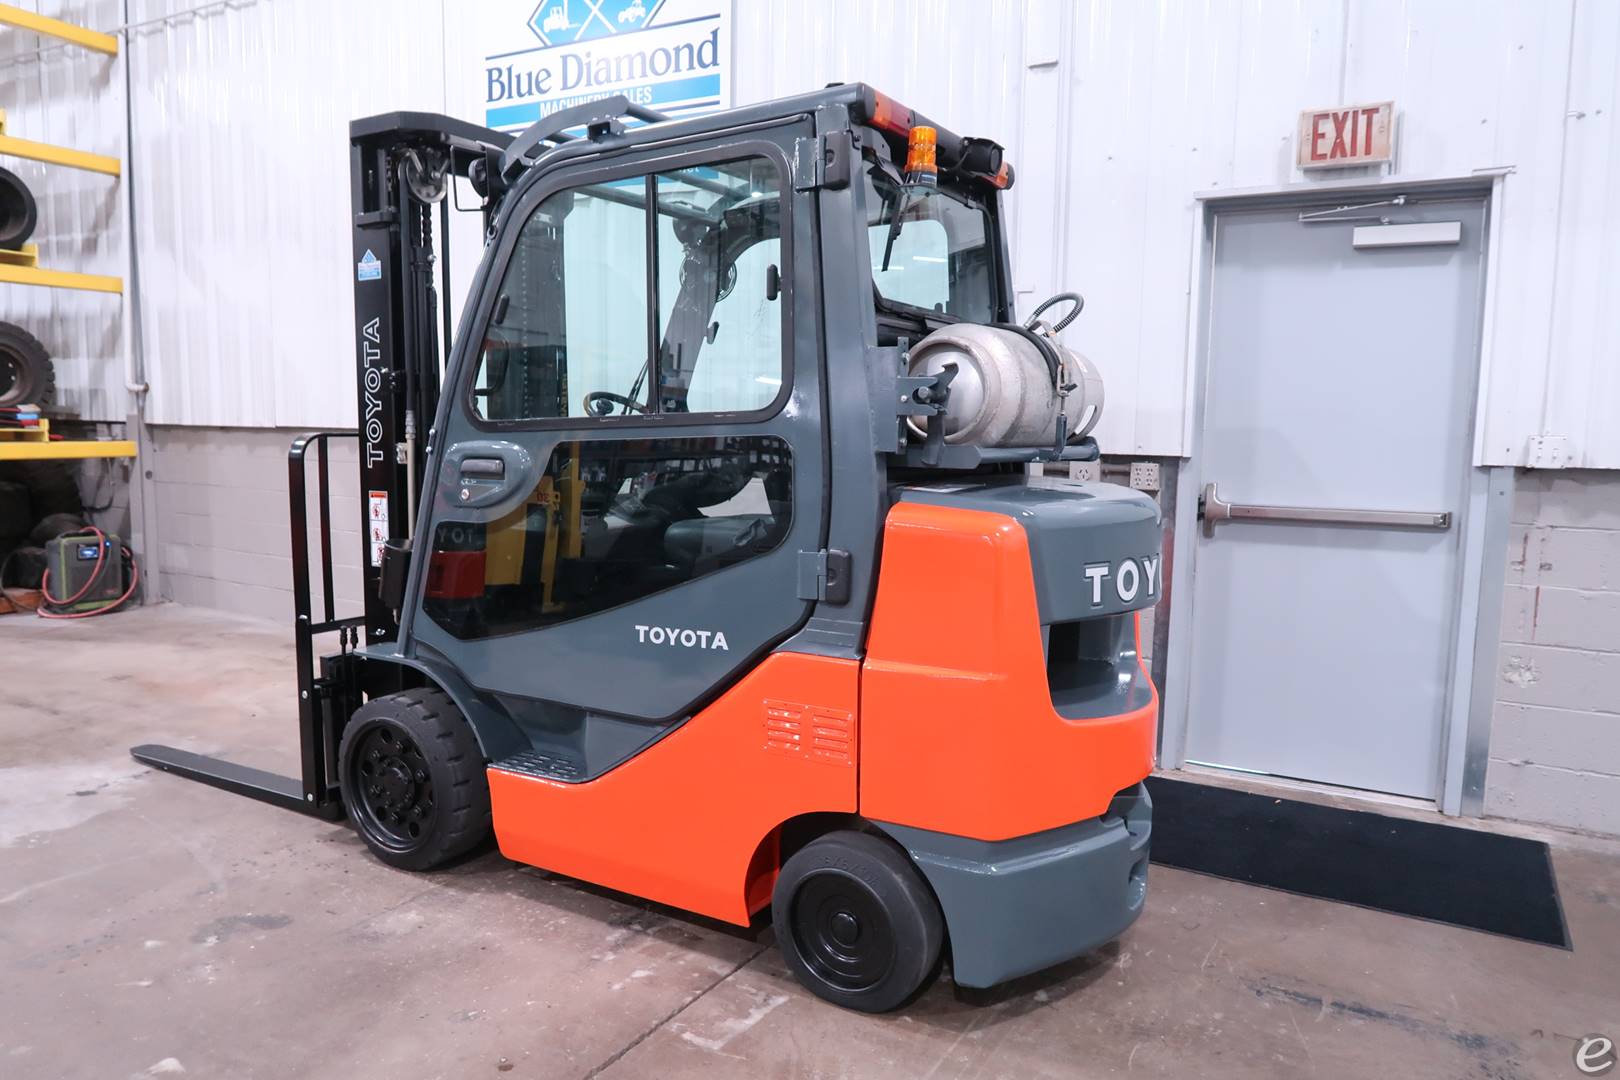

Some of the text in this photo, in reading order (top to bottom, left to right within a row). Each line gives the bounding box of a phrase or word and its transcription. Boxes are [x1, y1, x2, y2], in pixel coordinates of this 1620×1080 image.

[486, 27, 721, 103] Blue Diamond
[1310, 107, 1380, 161] EXIT
[362, 316, 384, 469] TOYOTA
[1085, 558, 1162, 603] TOY
[635, 625, 729, 651] TOYOTA
